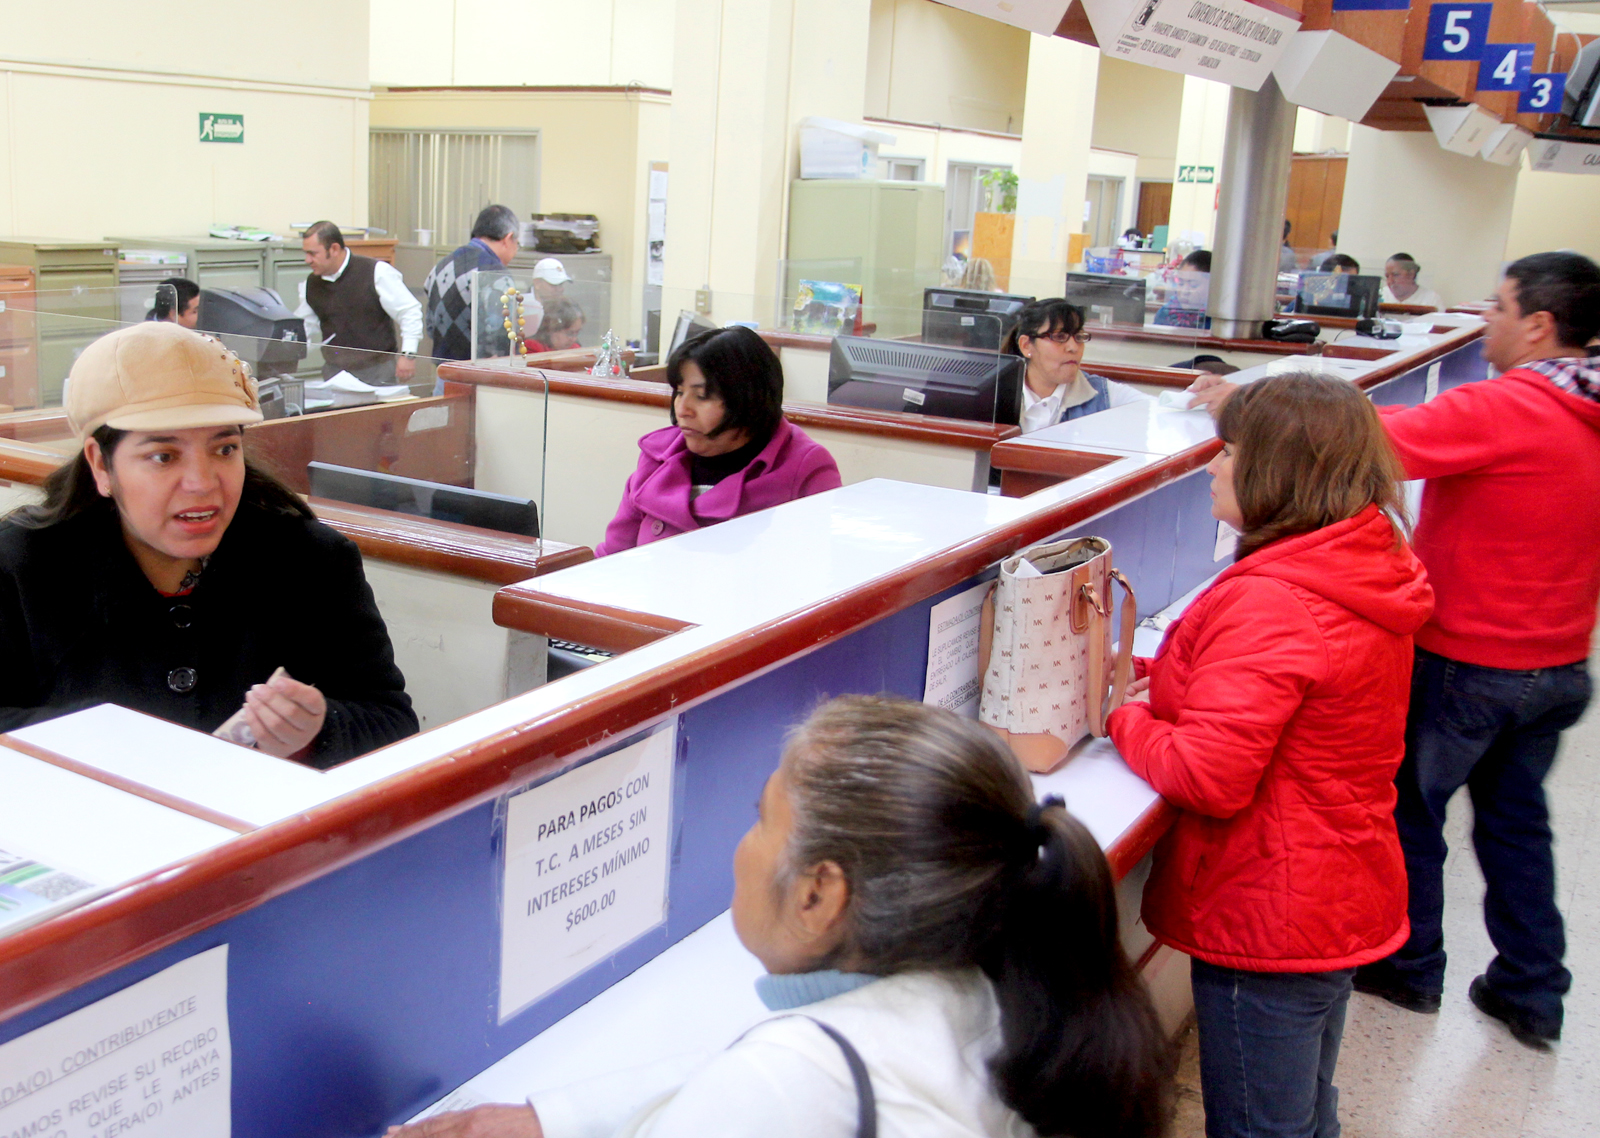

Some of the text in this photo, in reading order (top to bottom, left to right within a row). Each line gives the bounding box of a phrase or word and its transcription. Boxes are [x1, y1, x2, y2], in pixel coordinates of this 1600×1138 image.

[1442, 11, 1472, 53] 5
[1492, 49, 1518, 85] 4
[1529, 78, 1553, 108] 3
[1003, 605, 1013, 613] MK
[537, 772, 650, 842] PARA PAGOS CON
[535, 806, 648, 877] T.C. A MESES SIN
[527, 837, 650, 916] INTERESES MÍNIMO
[565, 889, 616, 932] $600.00
[61, 995, 197, 1073] CONTRIBUYENTE
[69, 1073, 129, 1116] REVISE
[135, 1059, 156, 1081] SU
[161, 1027, 218, 1067] RECIBO
[88, 1048, 220, 1128] QUE LE HAYA
[172, 1067, 220, 1104] ANTES
